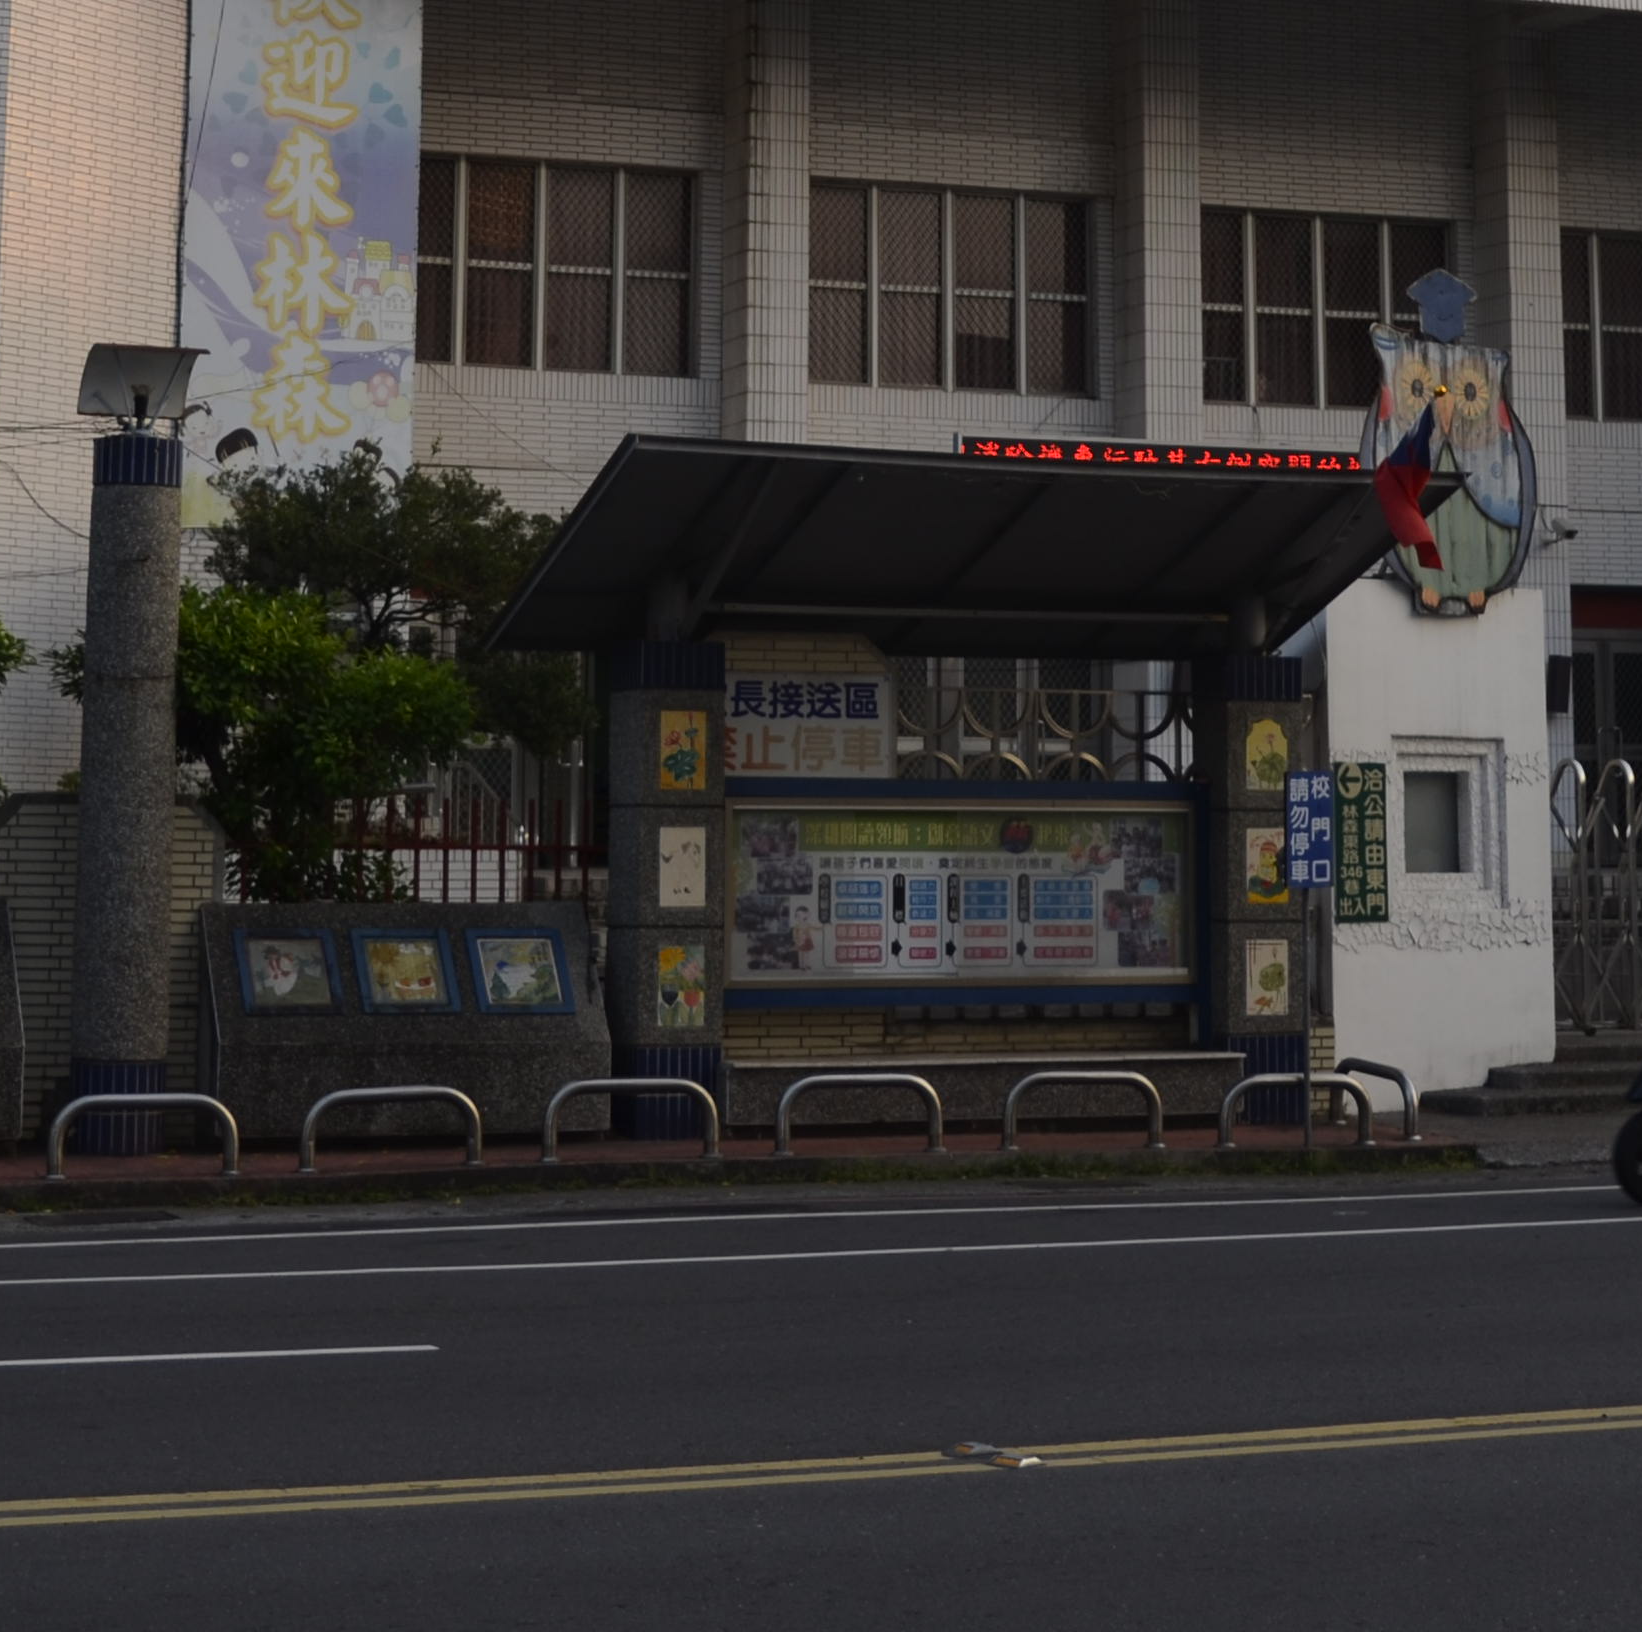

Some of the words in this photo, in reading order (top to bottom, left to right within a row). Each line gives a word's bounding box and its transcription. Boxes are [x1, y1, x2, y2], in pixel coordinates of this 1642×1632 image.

[725, 680, 879, 720] 長接送區
[1289, 778, 1310, 883] 請勿停車
[1311, 775, 1331, 883] 校門口
[1363, 769, 1386, 916] 洽公請由東門
